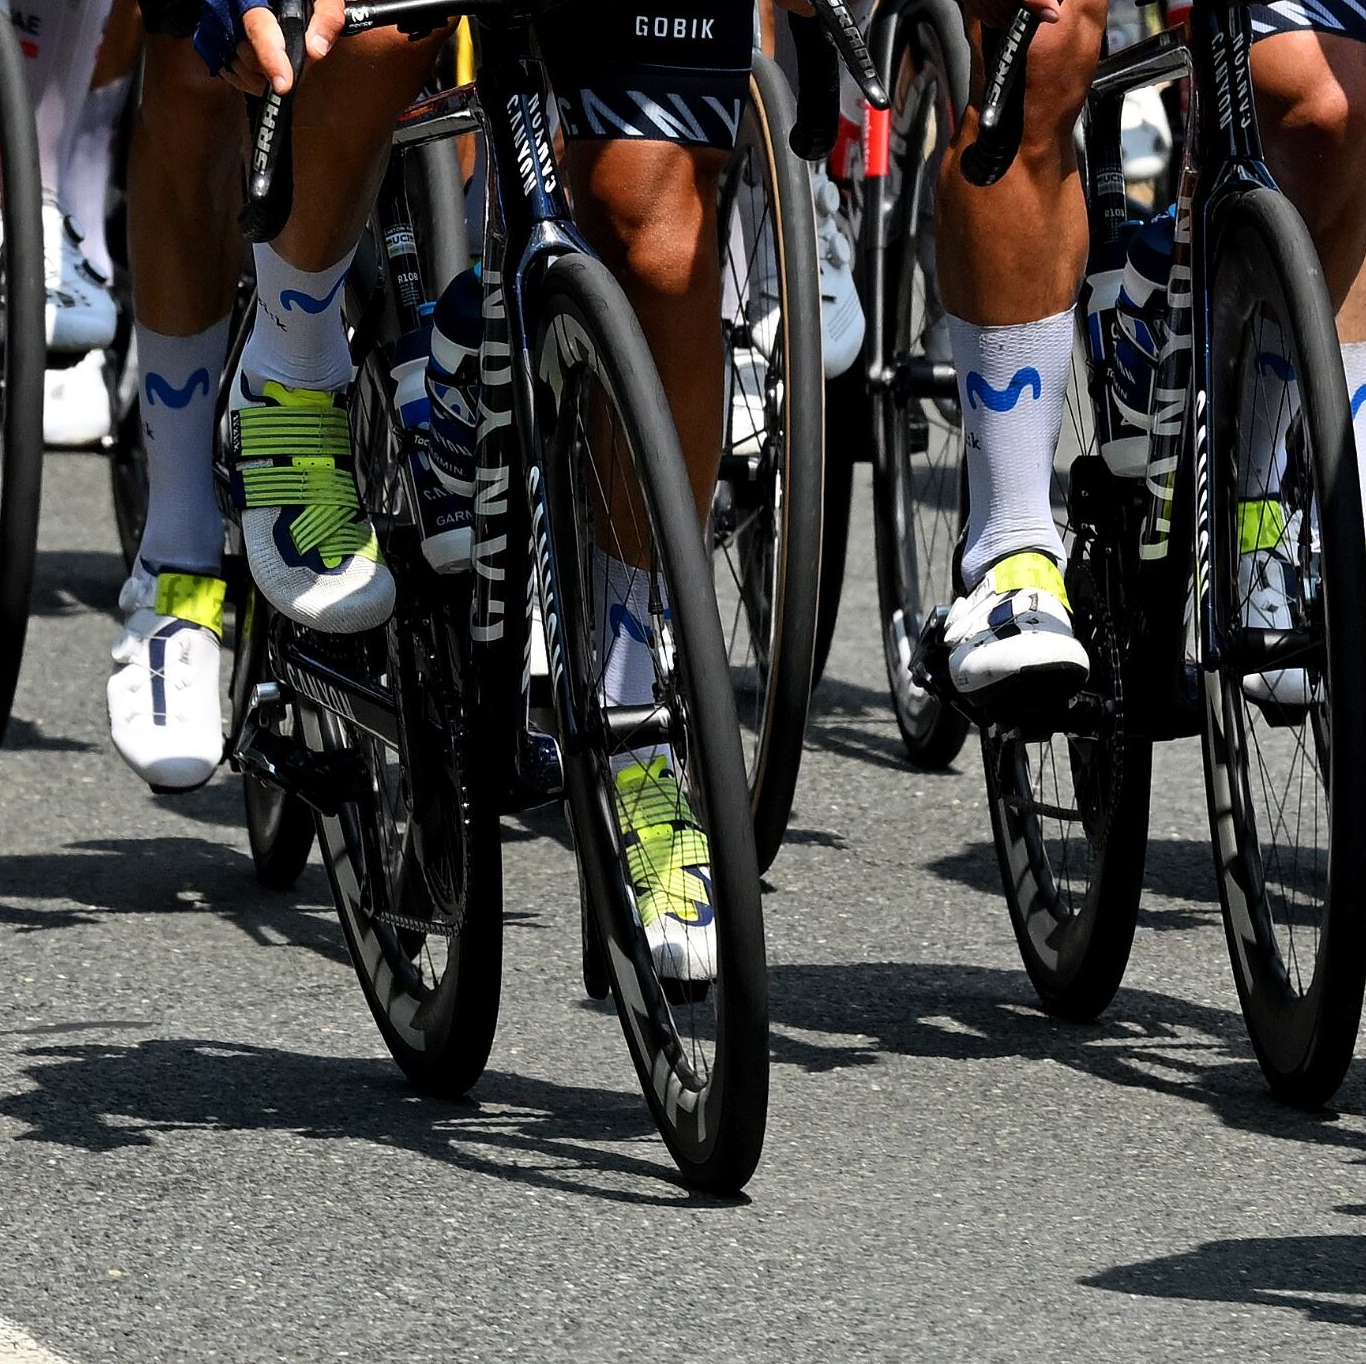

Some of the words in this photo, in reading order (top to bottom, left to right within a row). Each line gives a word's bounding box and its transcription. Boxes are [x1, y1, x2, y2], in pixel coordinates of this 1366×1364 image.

[636, 16, 714, 39] GOBIK
[1212, 32, 1232, 131] CANYON
[1232, 32, 1252, 129] CANYON
[505, 94, 535, 195] CANYON
[528, 91, 556, 193] CANYON
[471, 270, 513, 642] CANYON
[286, 662, 356, 720] CANYON
